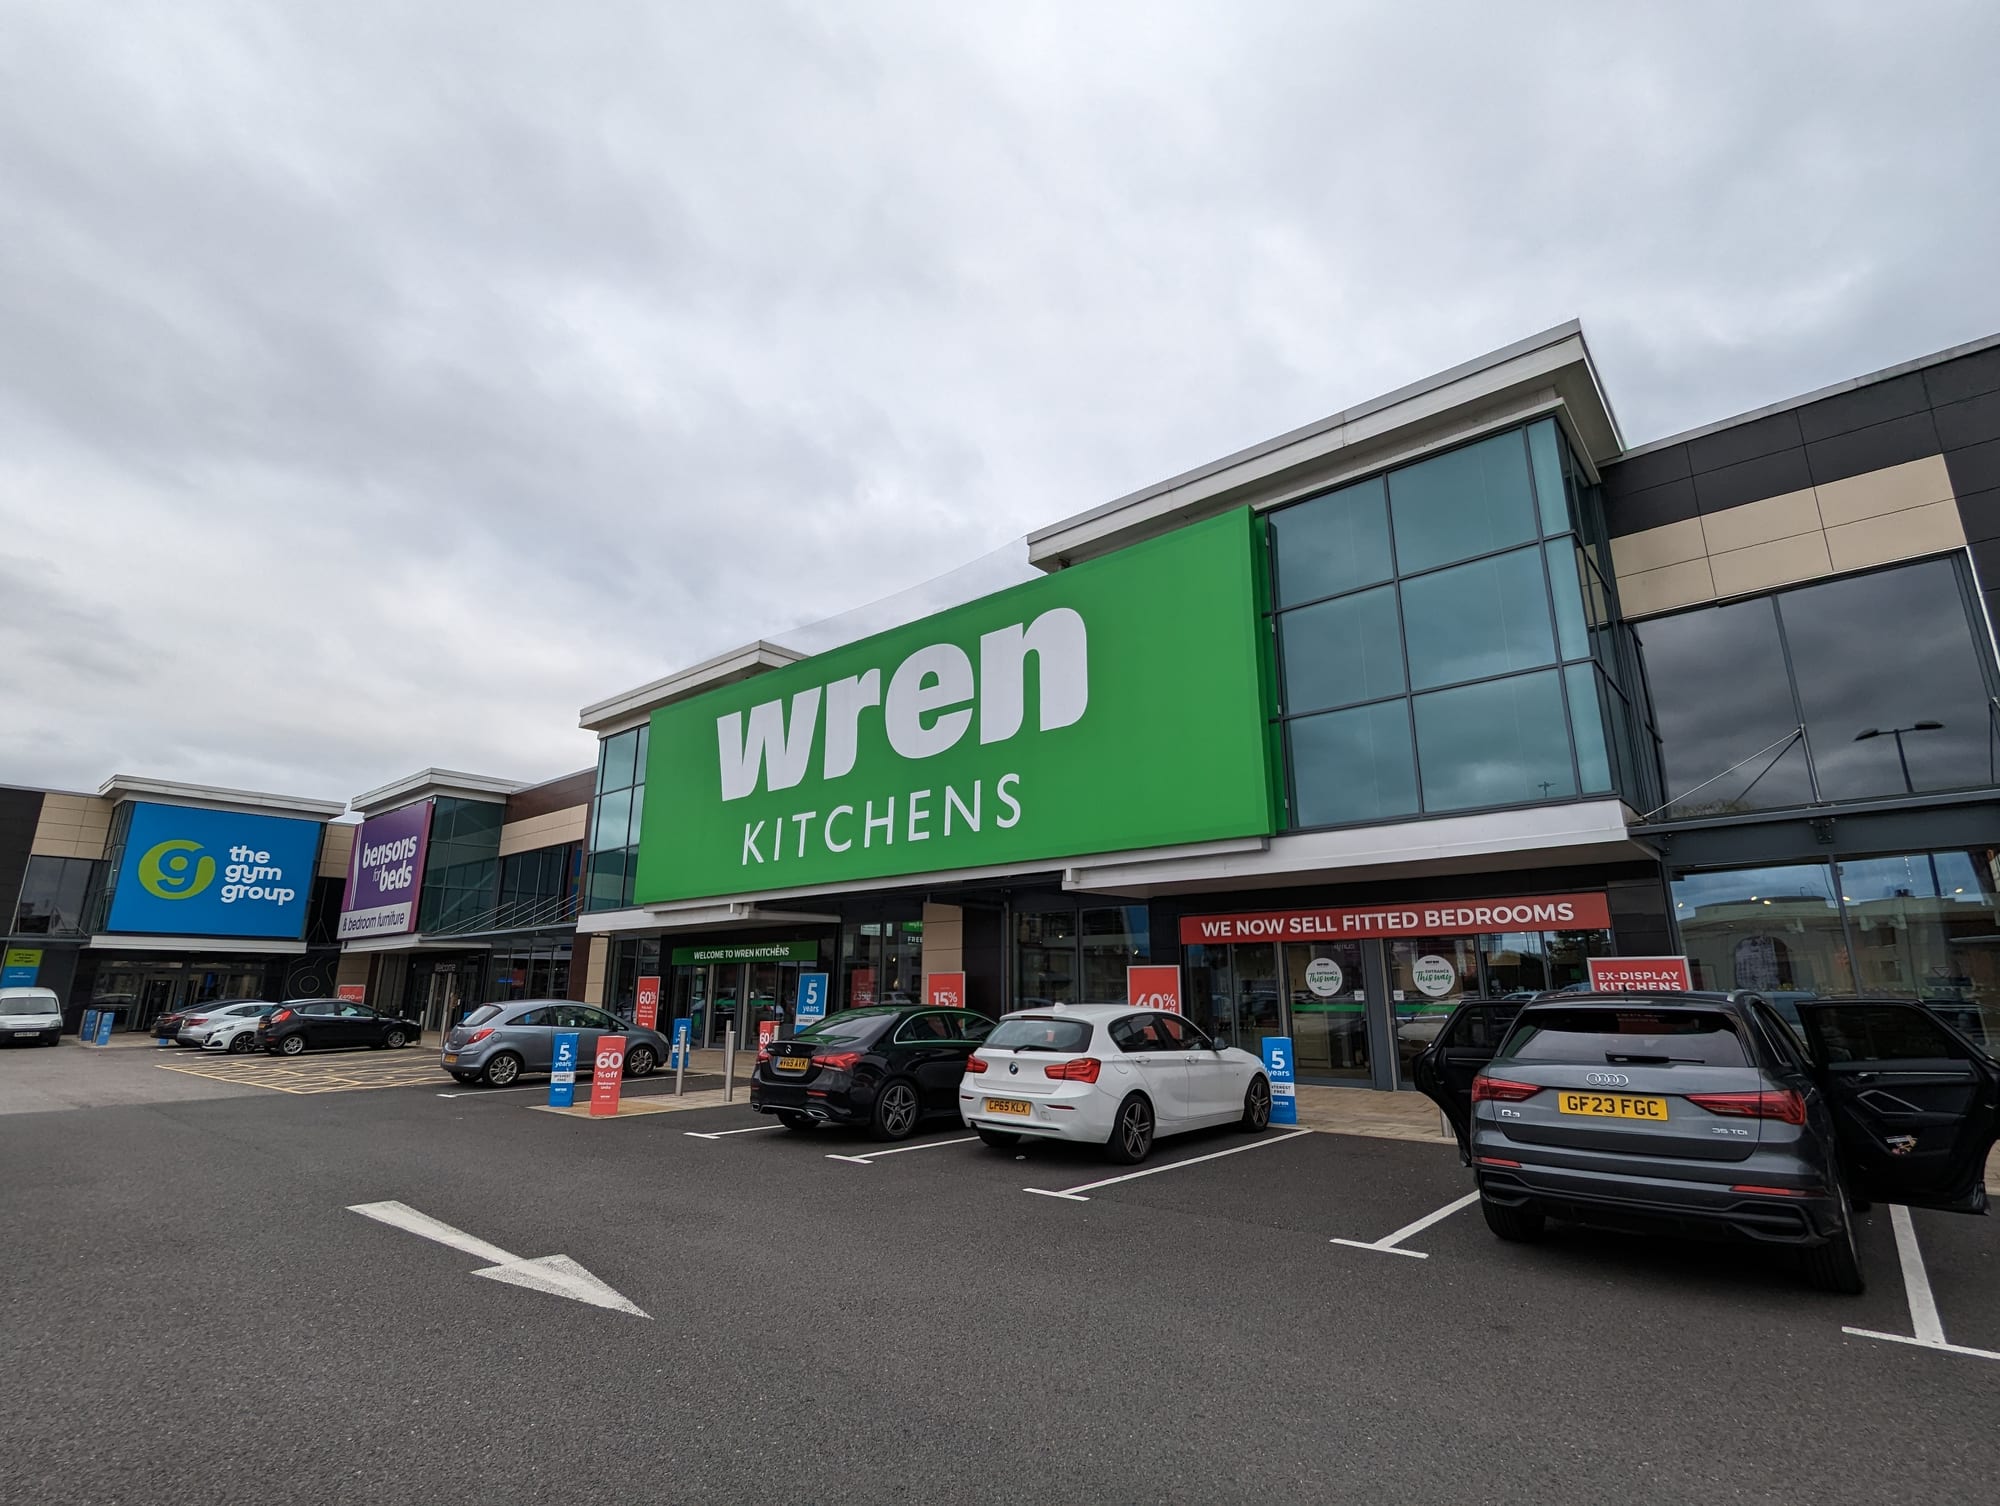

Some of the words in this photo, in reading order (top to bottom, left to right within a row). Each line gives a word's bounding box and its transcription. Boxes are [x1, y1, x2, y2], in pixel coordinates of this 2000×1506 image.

[716, 607, 1089, 801] wren
[742, 773, 1021, 866] KITCHENS
[229, 845, 270, 864] the
[362, 836, 417, 869] bensons
[225, 865, 282, 884] gym
[372, 868, 381, 882] for
[379, 860, 413, 892] beds
[221, 884, 295, 906] group
[347, 916, 377, 931] bedroom
[376, 911, 405, 928] furniture
[1201, 921, 1232, 937] WE
[1236, 918, 1285, 936] NOW
[1289, 916, 1337, 934] SELL
[1343, 911, 1419, 932] FITTED
[1425, 903, 1575, 928] BEDROOMS
[694, 950, 724, 960] WELCOME
[725, 950, 734, 958] TO
[734, 949, 754, 958] WREN
[755, 946, 790, 956] KITCHENS
[1597, 971, 1679, 981] EX-DISPLAY
[806, 982, 818, 1005] 5
[1599, 981, 1681, 992] KITCHENS
[802, 1005, 820, 1014] years
[559, 1044, 571, 1061] 5
[596, 1052, 624, 1069] 60
[1271, 1050, 1286, 1070] 5
[555, 1060, 572, 1068] years
[1267, 1069, 1290, 1077] years
[1010, 1102, 1027, 1113] KLX
[1501, 1109, 1521, 1118] Q3
[1567, 1095, 1616, 1114] GF23
[1621, 1098, 1660, 1117] FGC
[1711, 1127, 1729, 1135] 35
[1730, 1128, 1749, 1136] TDI
